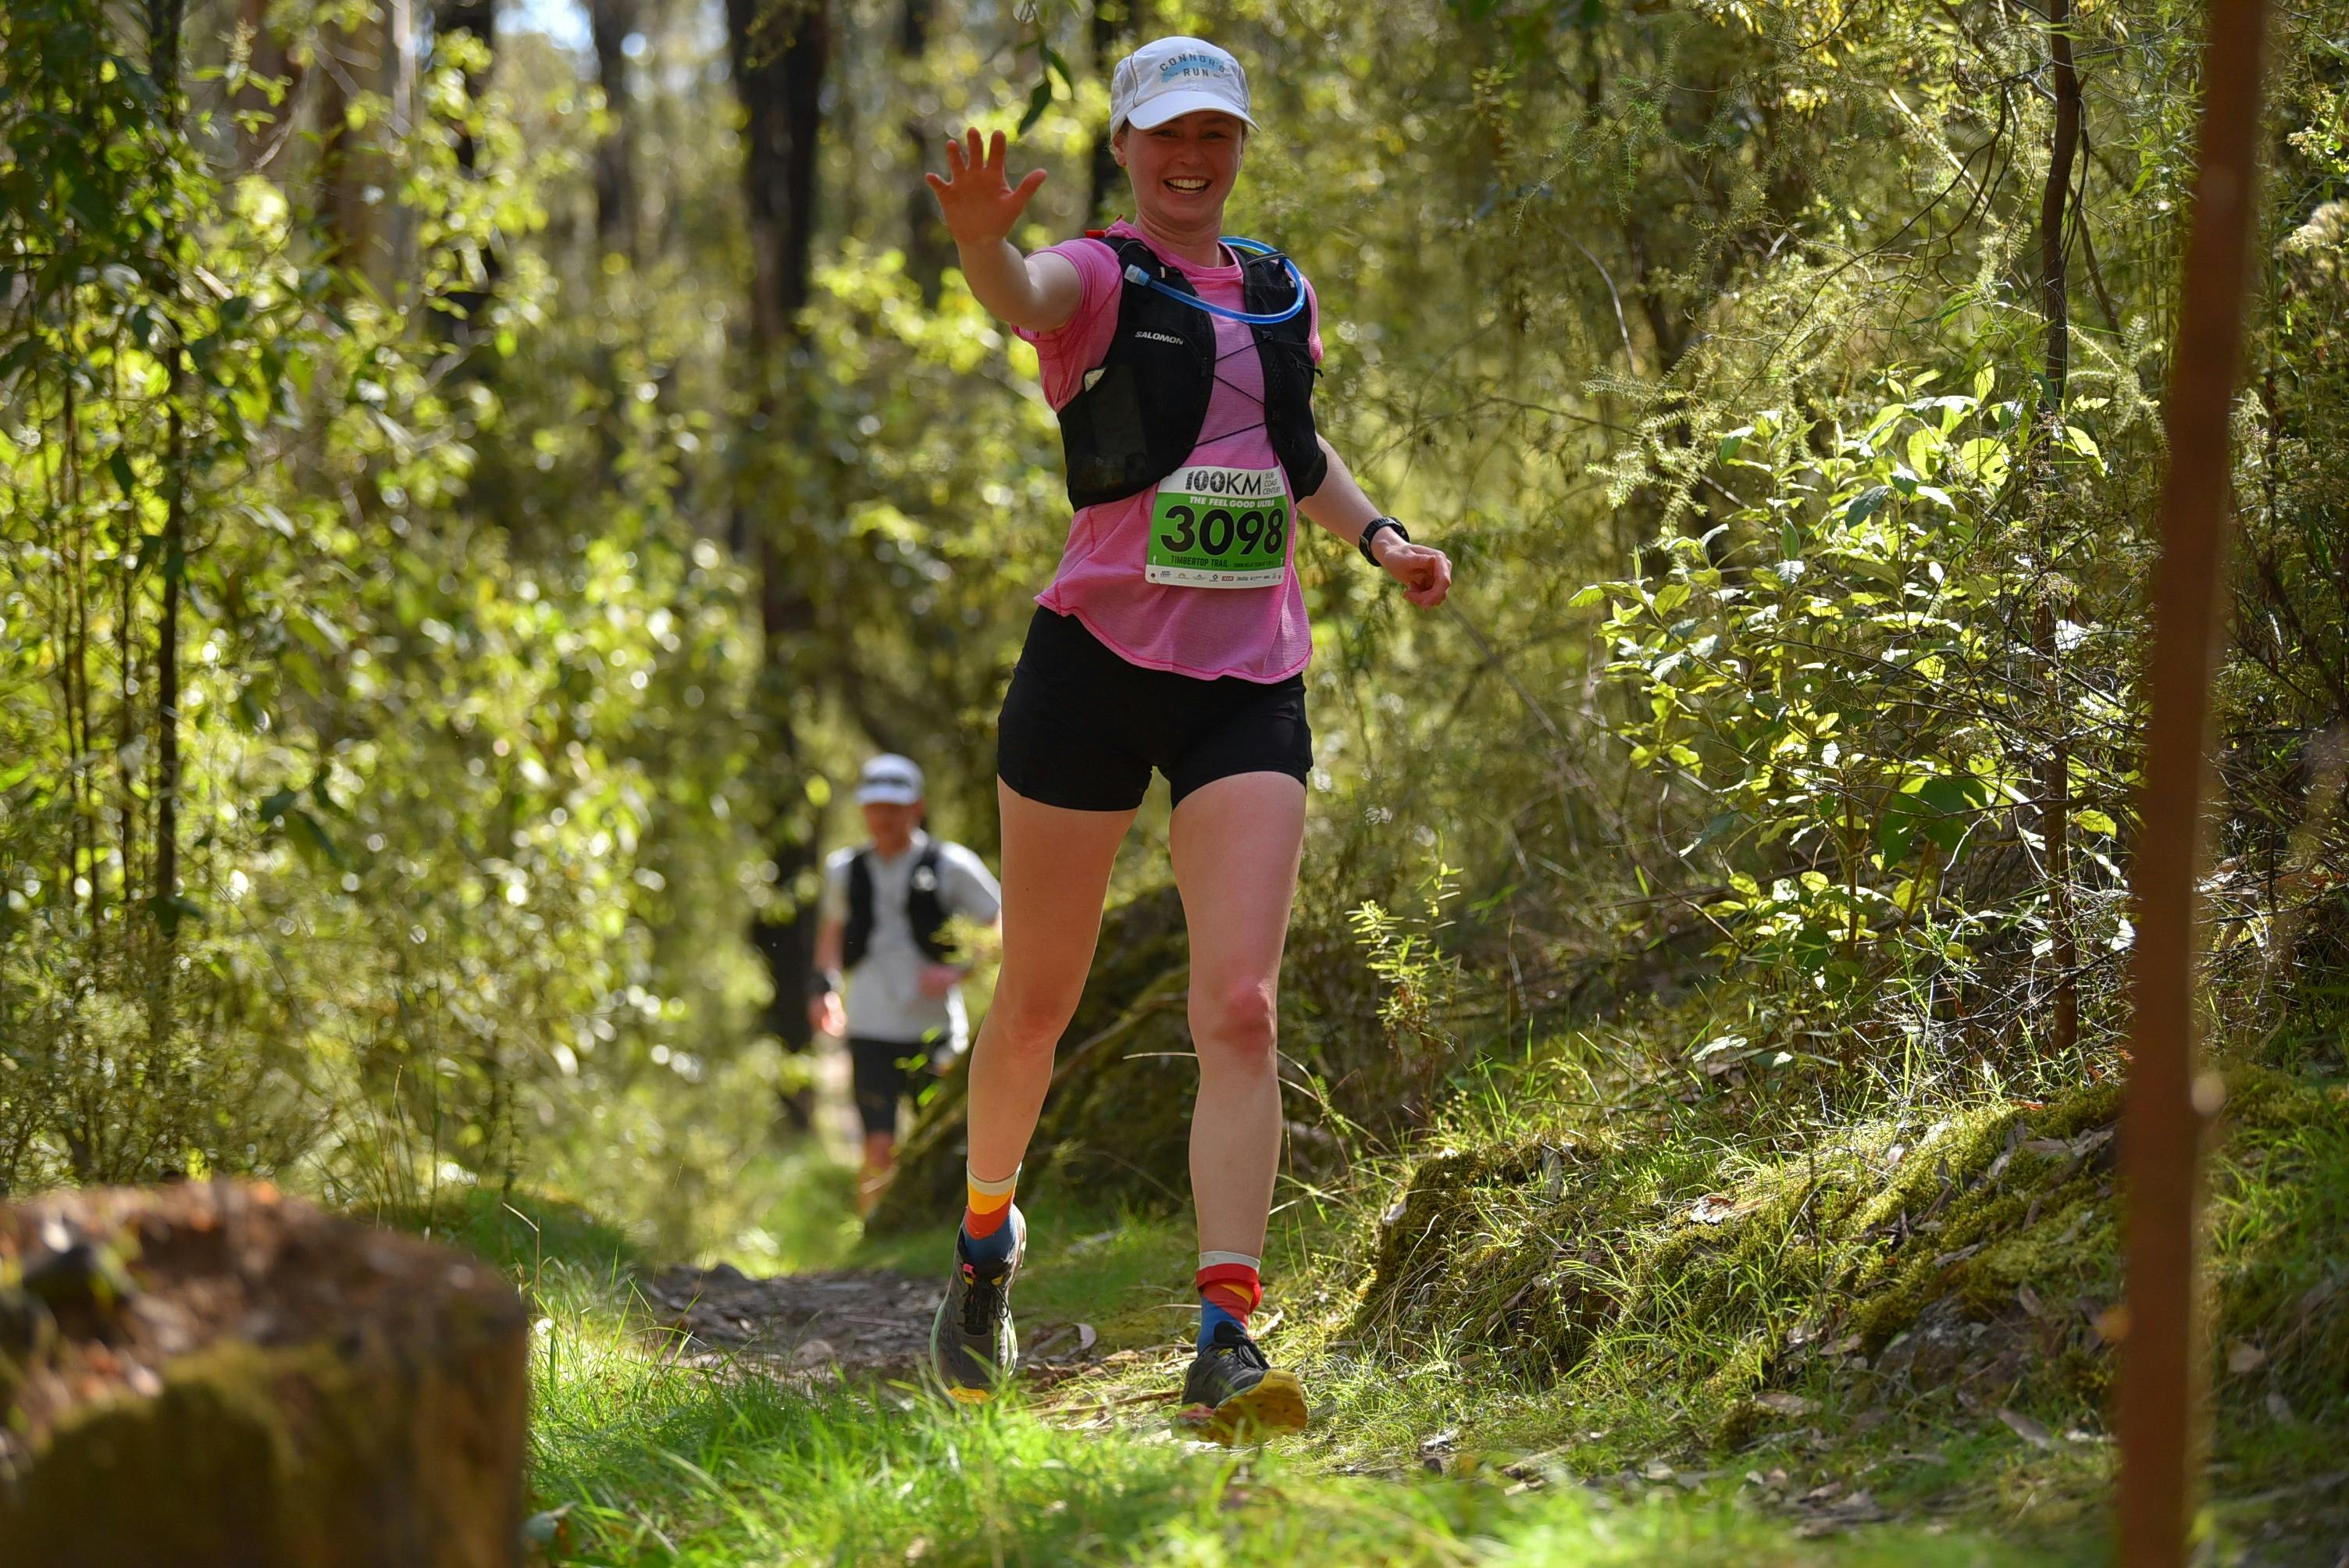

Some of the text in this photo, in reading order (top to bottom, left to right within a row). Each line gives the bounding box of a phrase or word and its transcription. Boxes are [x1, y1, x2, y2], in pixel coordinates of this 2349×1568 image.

[1159, 53, 1225, 73] CONNOR'S
[1183, 68, 1209, 77] RUN
[1135, 331, 1184, 345] SALOMON
[1185, 470, 1262, 496] 100KM
[1189, 496, 1206, 504] THE
[1229, 500, 1255, 508] GOOD
[1160, 505, 1283, 556] 3098
[1171, 555, 1209, 567] TIMBERTOP
[1210, 558, 1229, 568] TRAIL
